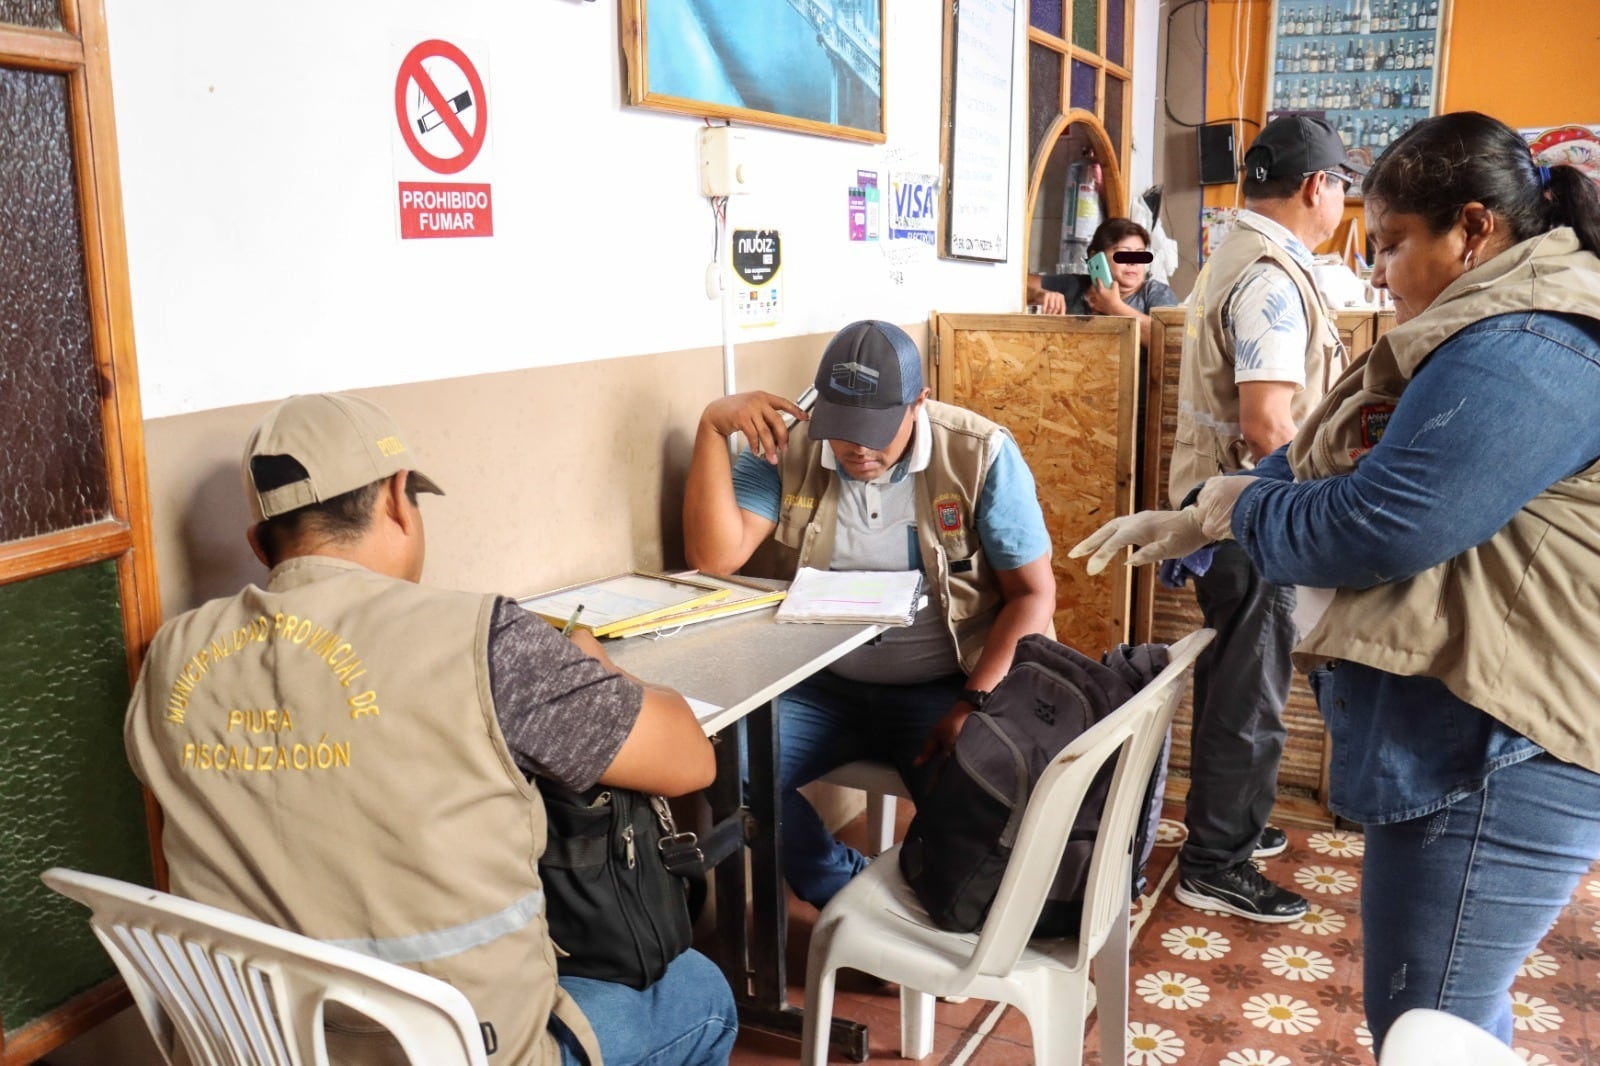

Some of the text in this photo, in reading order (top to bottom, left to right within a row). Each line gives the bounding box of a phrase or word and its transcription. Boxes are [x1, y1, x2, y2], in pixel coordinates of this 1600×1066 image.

[402, 190, 488, 210] PROHIBIDO
[893, 182, 934, 219] VISA
[419, 212, 475, 231] FUMAR
[165, 612, 380, 725] MUNICIPALIDAD PROVINCIAL DE
[227, 709, 294, 734] PIURA
[182, 732, 350, 771] FISCALIZACIÓN
